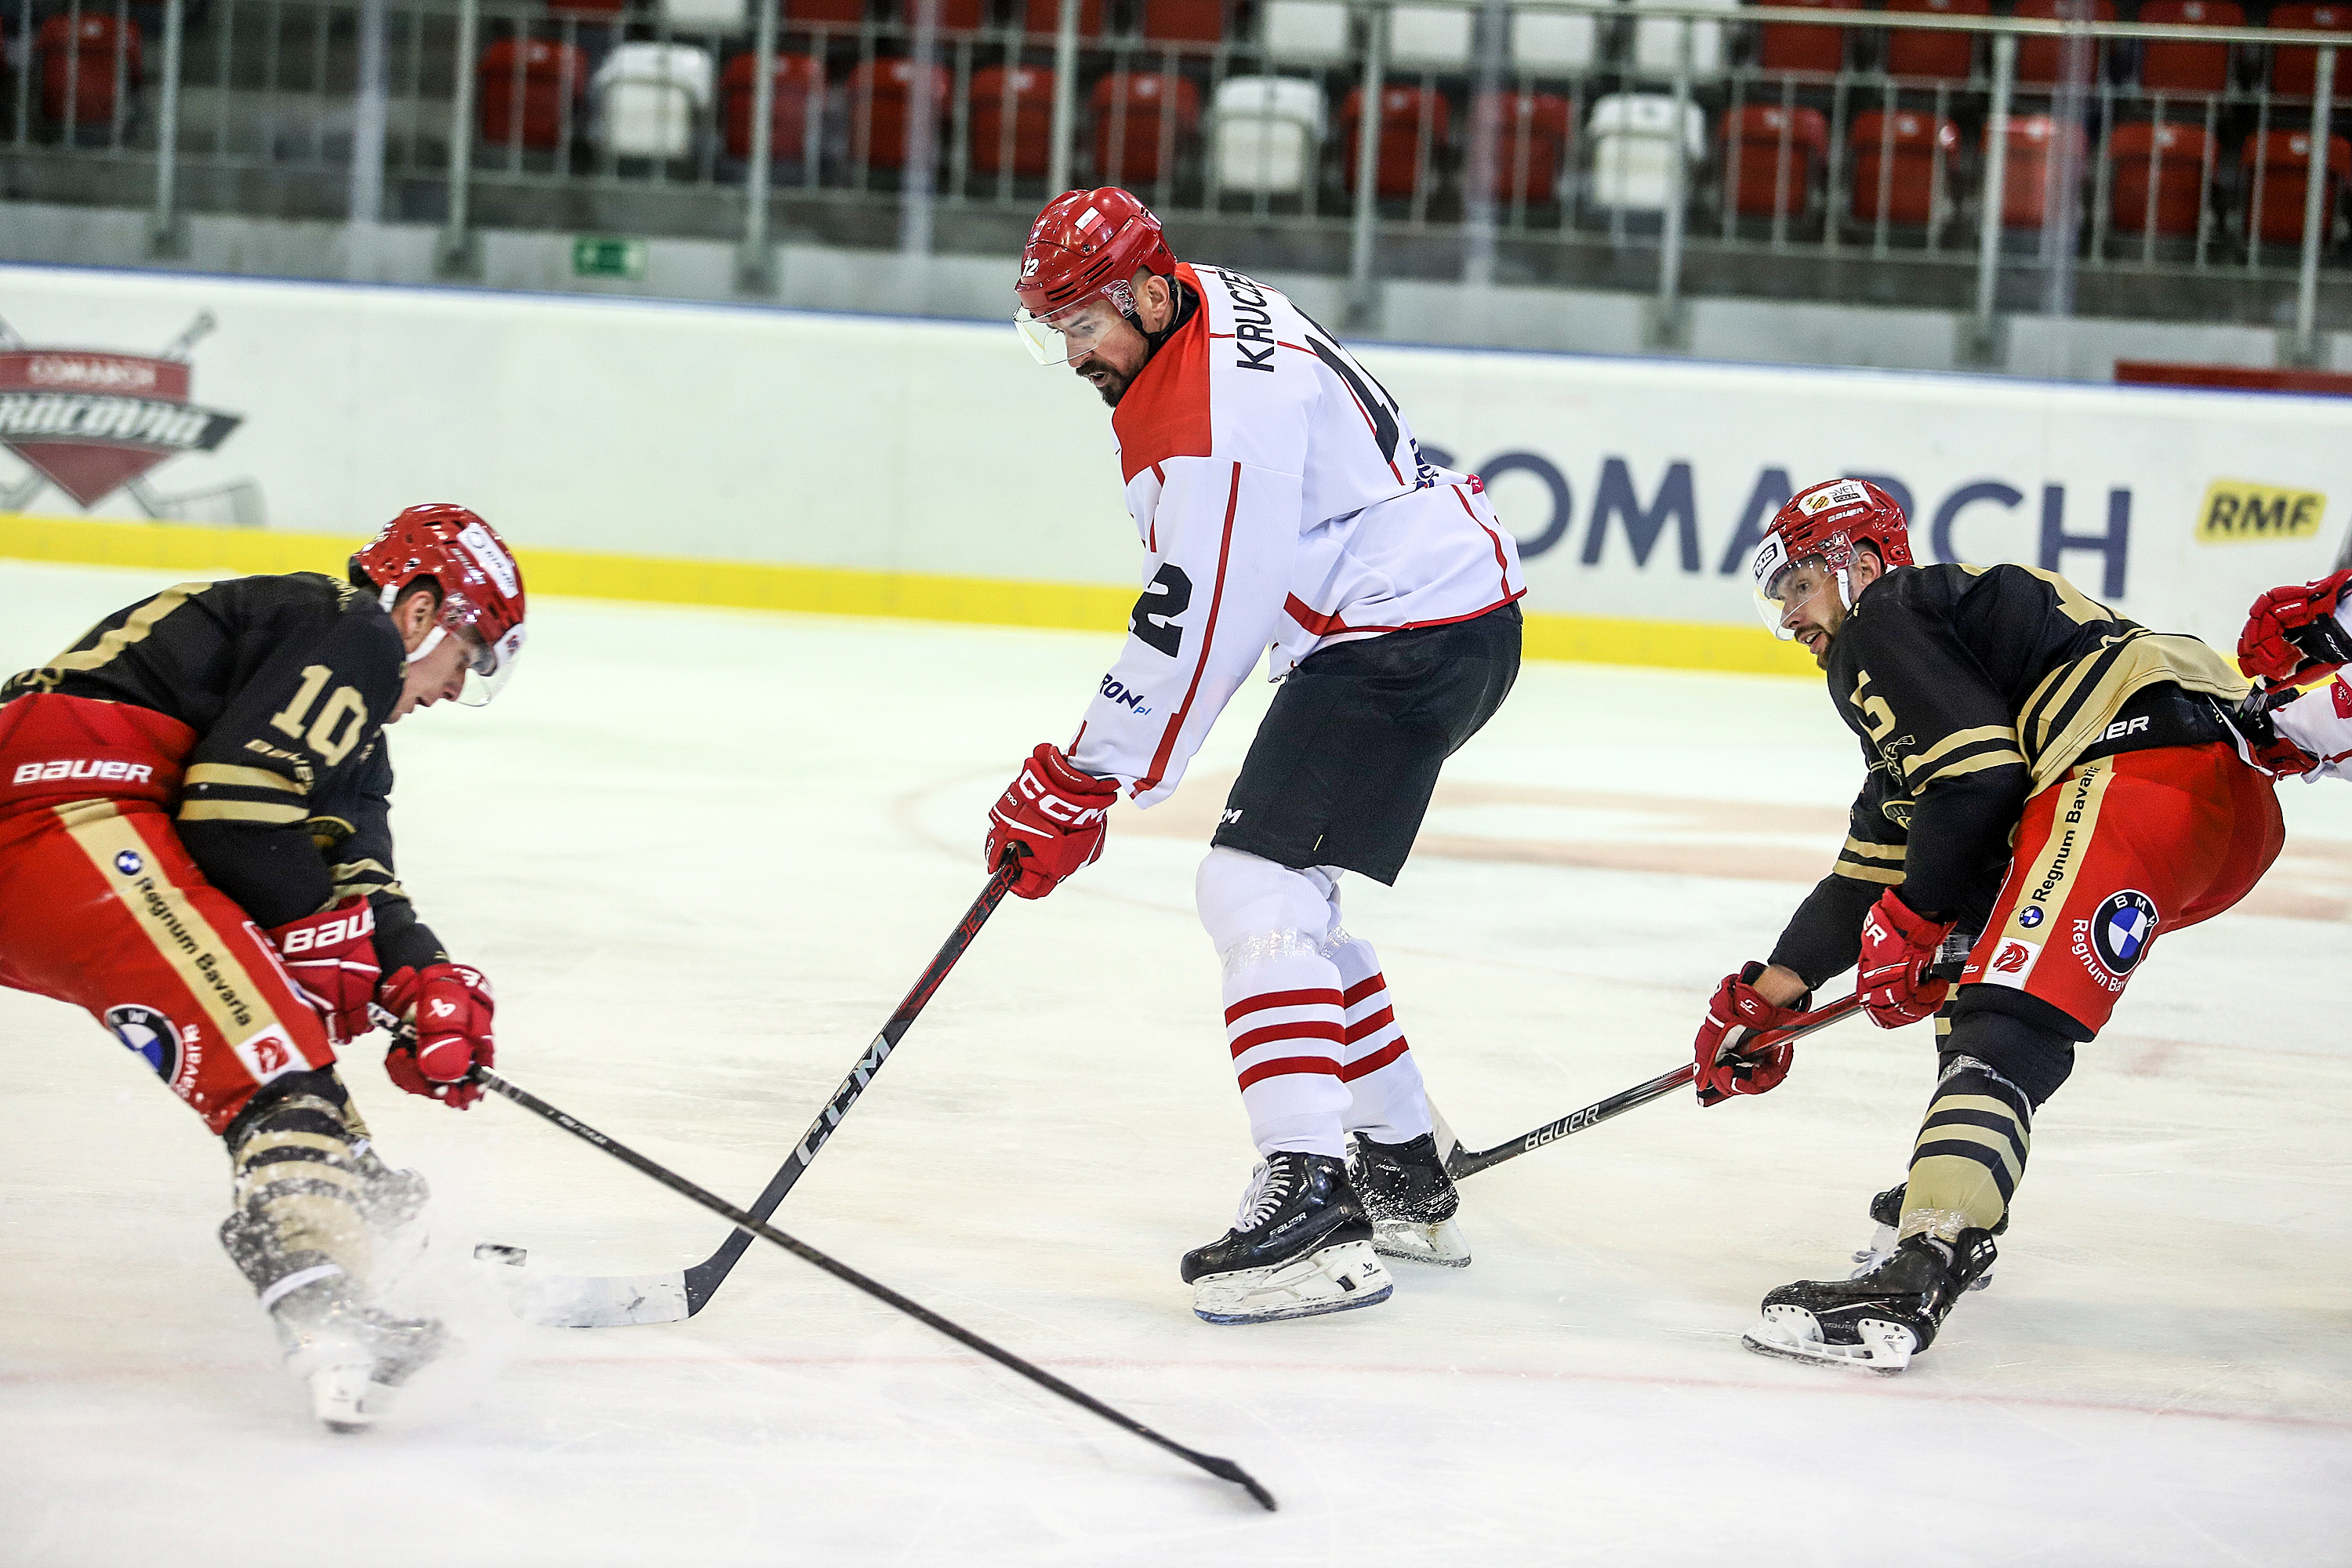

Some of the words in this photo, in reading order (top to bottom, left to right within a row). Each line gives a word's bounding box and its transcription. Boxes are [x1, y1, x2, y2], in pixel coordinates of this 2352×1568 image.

[1021, 256, 1040, 278] 12
[2205, 492, 2318, 532] RMF
[1131, 561, 1193, 659] 2
[269, 664, 368, 767] 10
[1004, 791, 1018, 807] PRO
[1018, 768, 1104, 826] CCM
[2031, 829, 2076, 903] Regnum
[282, 906, 376, 954] BAU
[2114, 895, 2156, 928] BMW
[133, 877, 199, 955] Regnum
[194, 952, 252, 1026] Bavaria
[2071, 918, 2108, 987] Regnum
[796, 1033, 892, 1167] CCM
